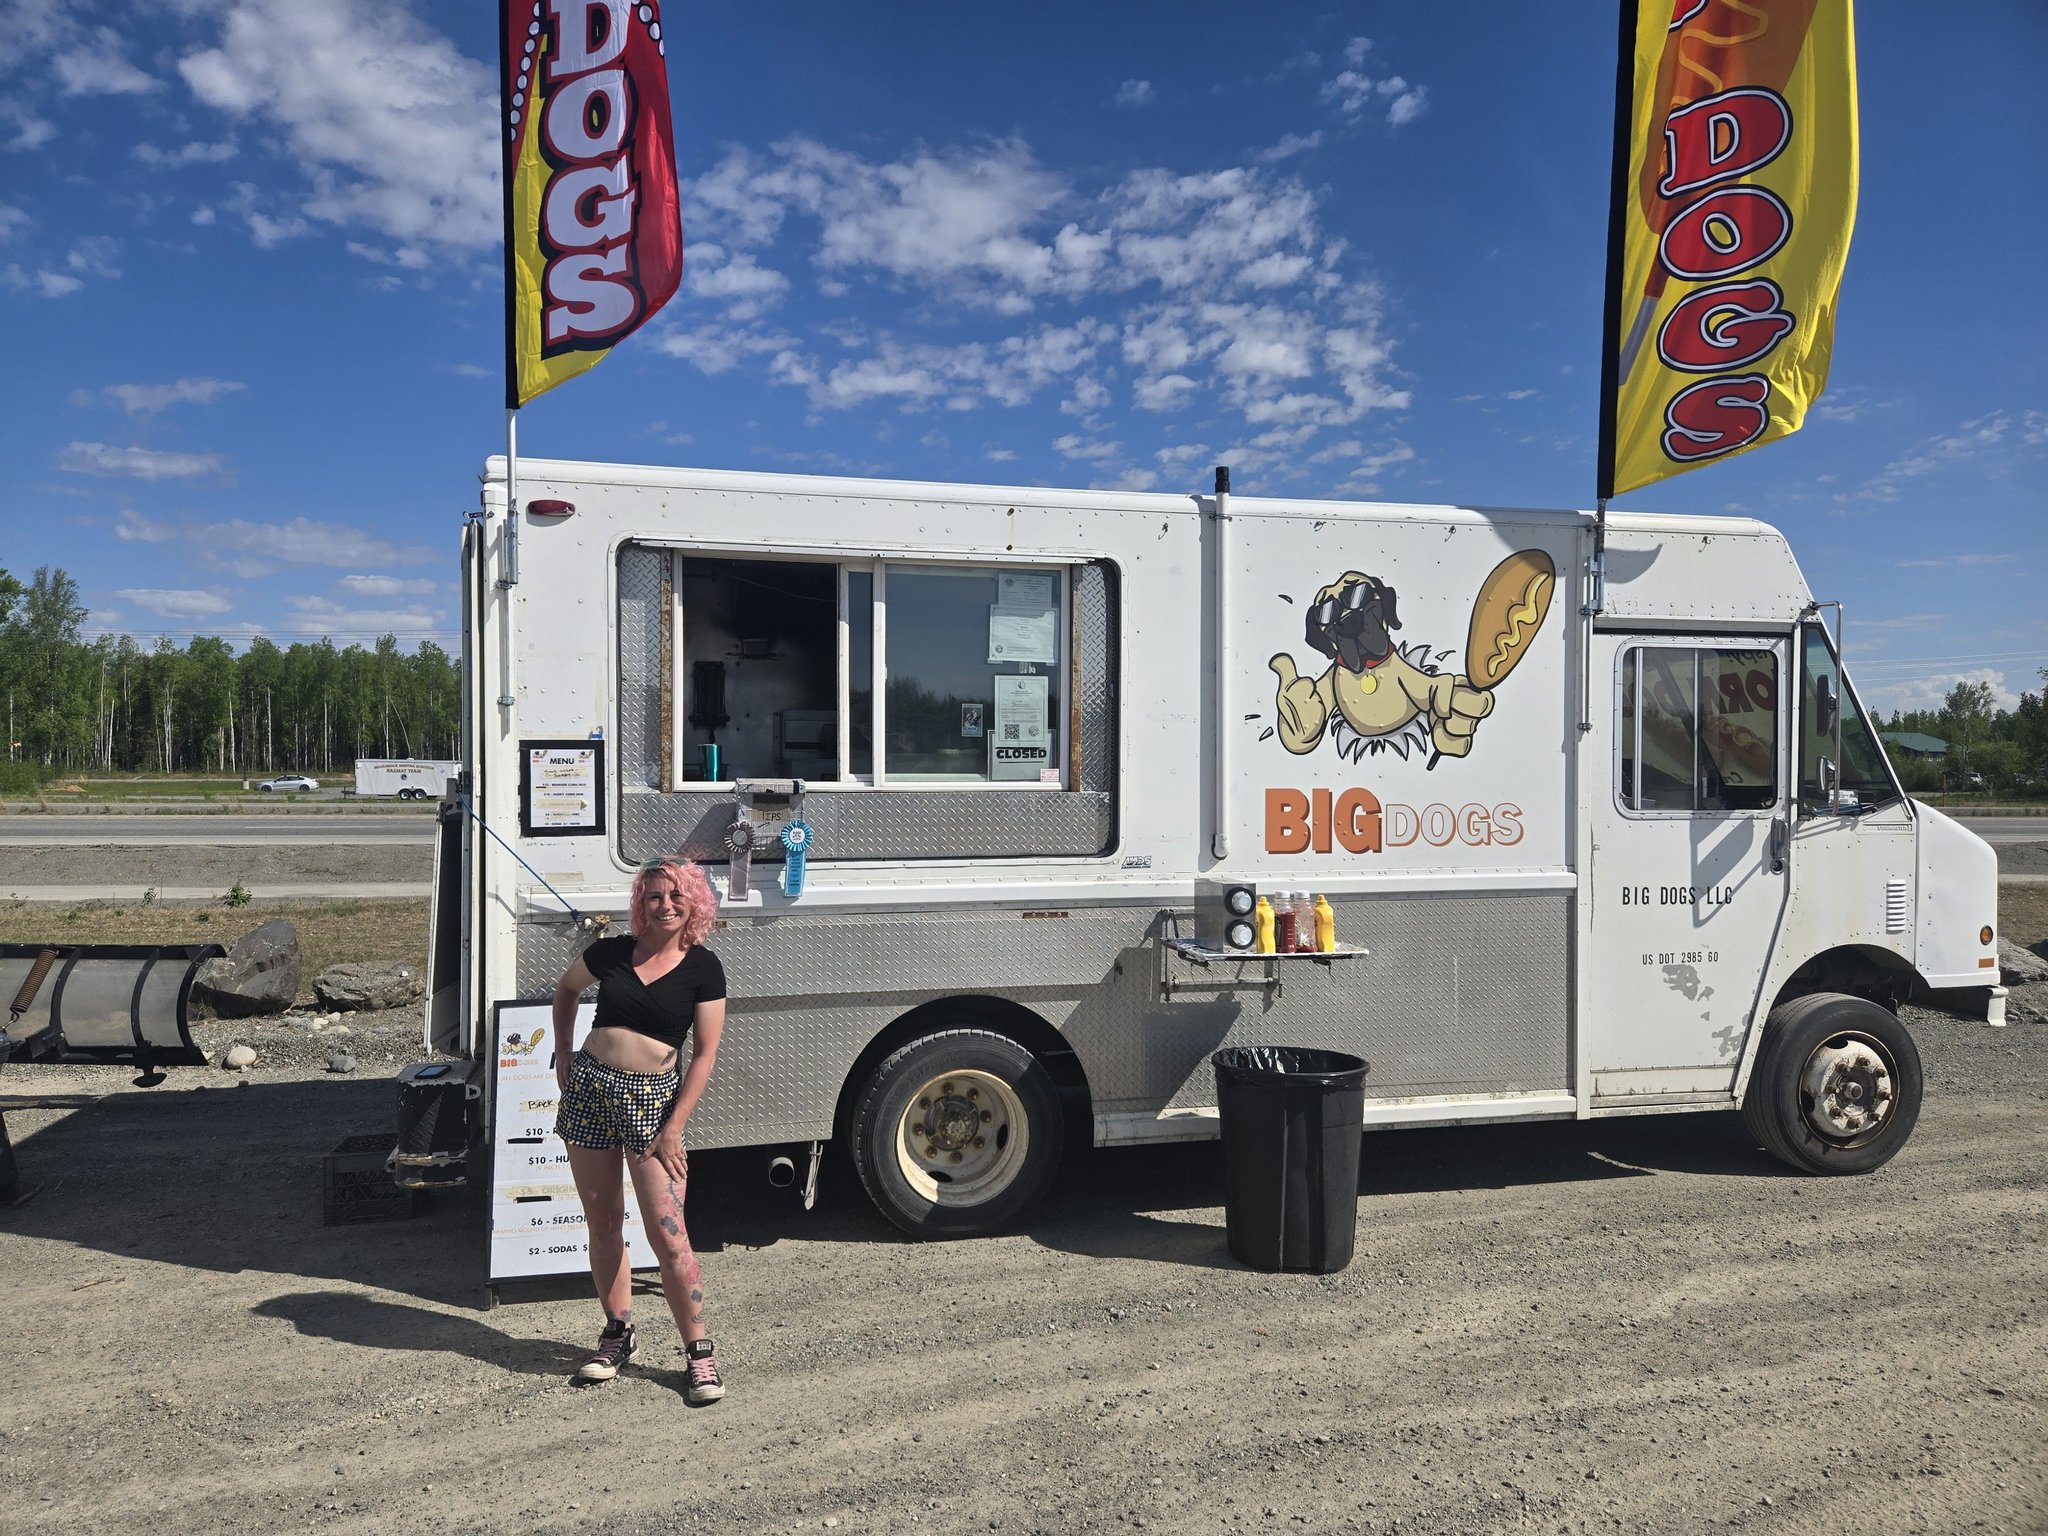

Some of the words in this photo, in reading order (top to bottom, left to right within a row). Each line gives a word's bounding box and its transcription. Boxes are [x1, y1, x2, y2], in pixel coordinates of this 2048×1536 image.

[545, 0, 638, 343] DOGS
[1658, 86, 1795, 463] DOGS
[996, 749, 1047, 759] CLOSED
[762, 810, 782, 821] TIPS
[1265, 787, 1382, 854] BIG
[1386, 802, 1524, 847] DOGS
[1622, 887, 1650, 905] BIG
[1660, 887, 1696, 905] DOGS
[1706, 886, 1733, 905] LLC
[1642, 953, 1653, 965] US
[1658, 953, 1675, 964] DOT
[1681, 952, 1703, 964] 2985
[500, 1059, 518, 1068] BIG
[528, 1100, 555, 1110] BACK
[525, 1127, 544, 1137] $10
[528, 1156, 546, 1165] $10
[542, 1186, 576, 1194] ORIGIN
[530, 1218, 543, 1226] $6
[528, 1247, 540, 1256] $2
[548, 1244, 577, 1254] SODAS
